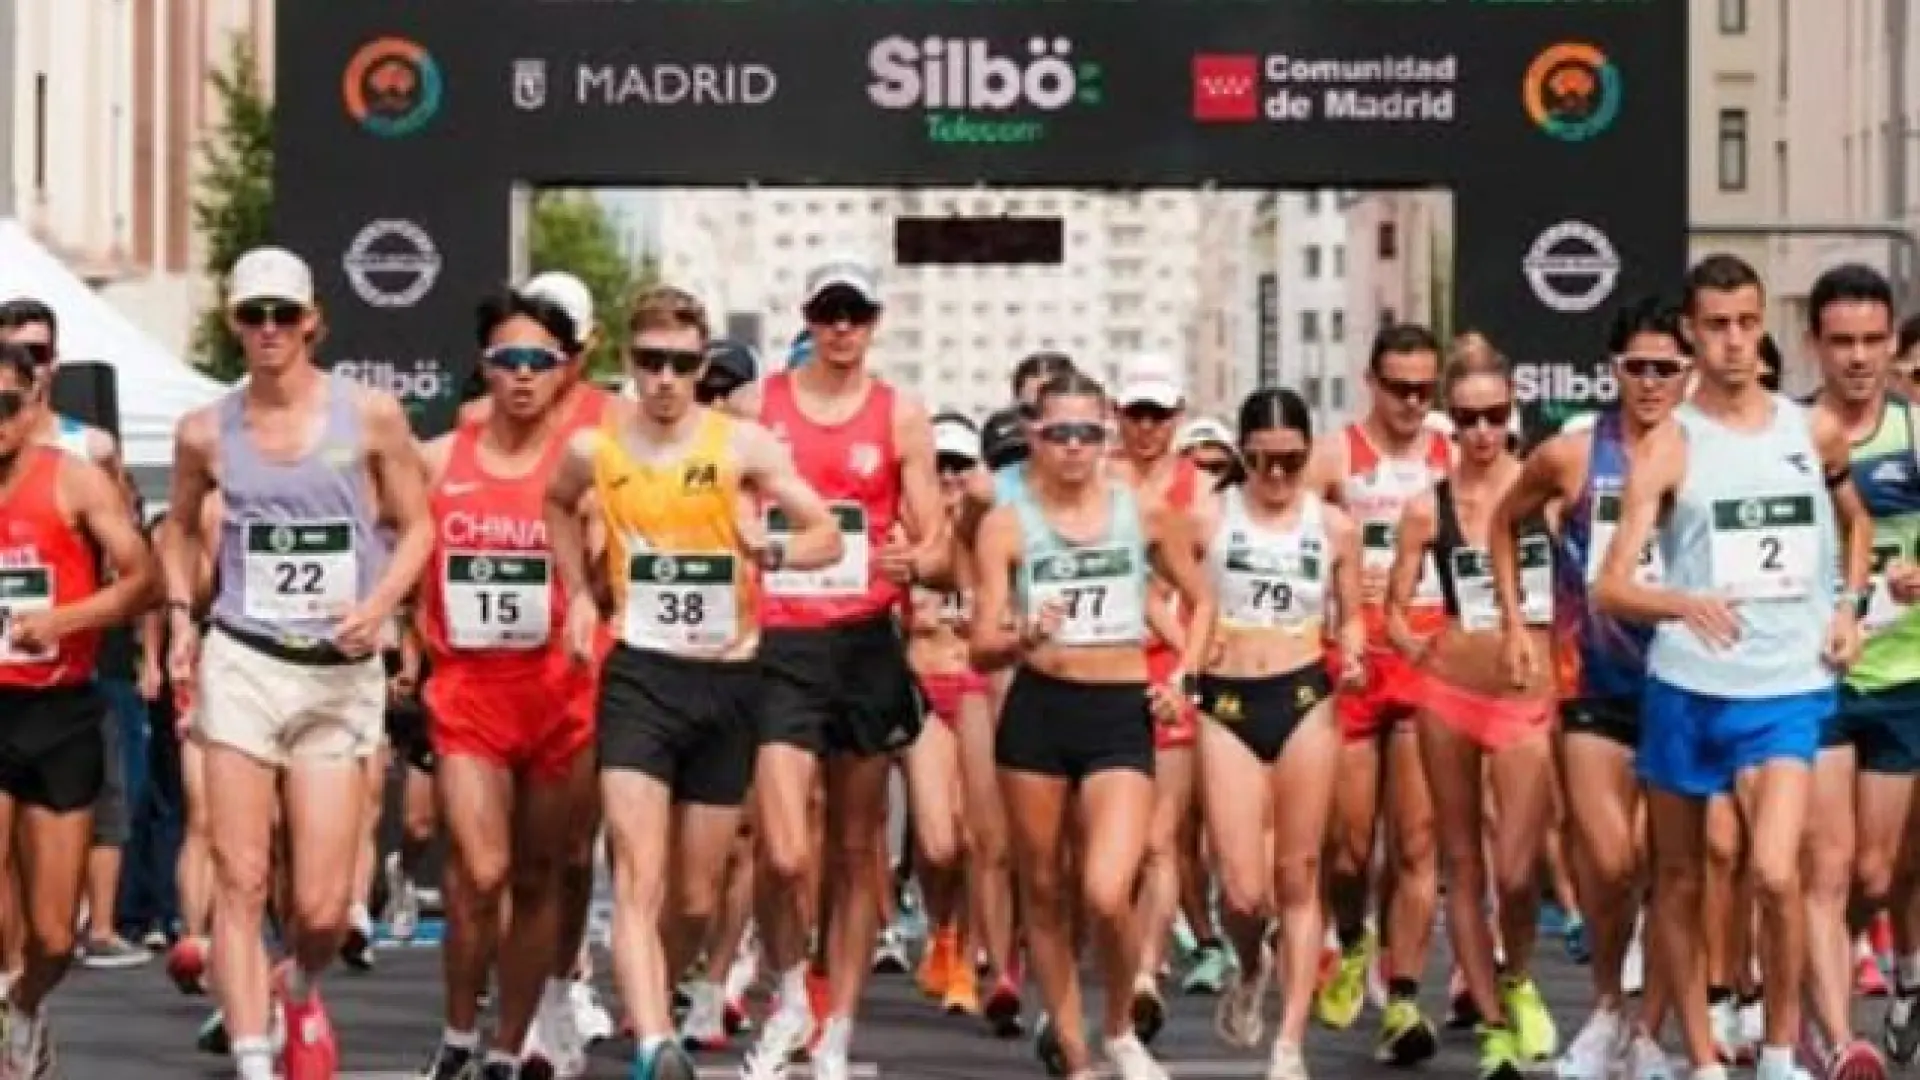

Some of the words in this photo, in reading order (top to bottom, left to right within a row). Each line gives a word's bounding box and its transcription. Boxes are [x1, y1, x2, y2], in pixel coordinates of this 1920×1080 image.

[576, 63, 778, 104] MADRID
[1265, 54, 1457, 82] Comunidad
[1265, 89, 1312, 121] de
[1324, 89, 1456, 121] Madrid
[443, 511, 546, 548] CHINA
[1759, 537, 1785, 570] 2
[275, 561, 325, 594] 22
[475, 591, 520, 625] 15
[658, 592, 704, 625] 38
[1061, 586, 1107, 619] 77
[1251, 580, 1292, 612] 79
